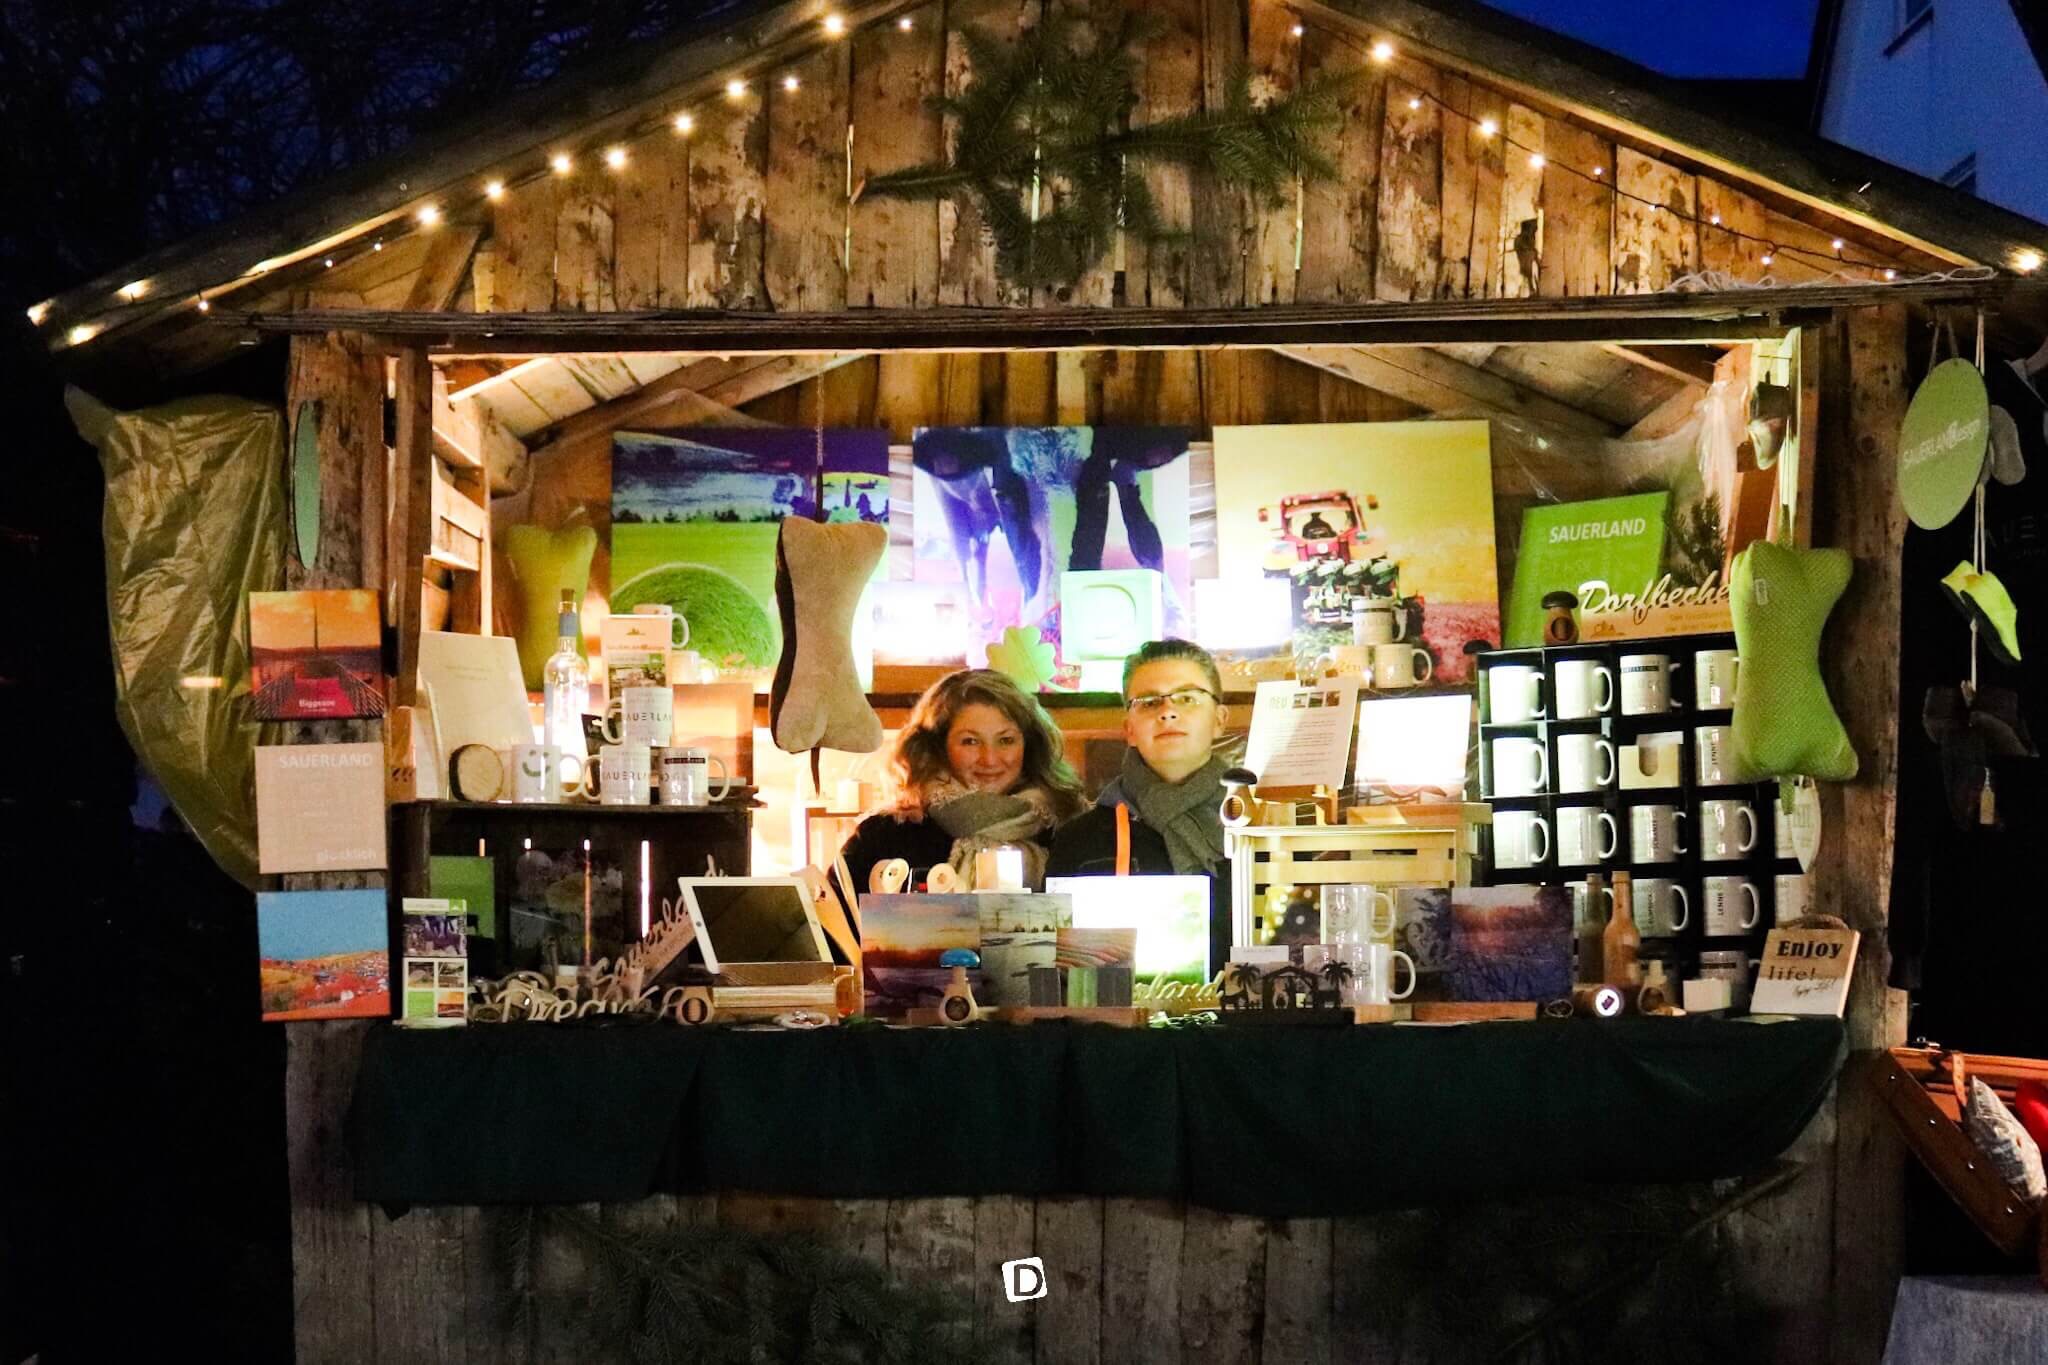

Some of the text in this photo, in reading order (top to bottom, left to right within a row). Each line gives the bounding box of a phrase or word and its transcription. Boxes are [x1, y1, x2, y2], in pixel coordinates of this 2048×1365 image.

[1550, 518, 1646, 543] SAUERLAND
[1578, 570, 1730, 625] Dorfbeche
[279, 752, 373, 769] SAUERLAND
[1776, 940, 1845, 960] Enjoy
[1767, 965, 1817, 982] life!
